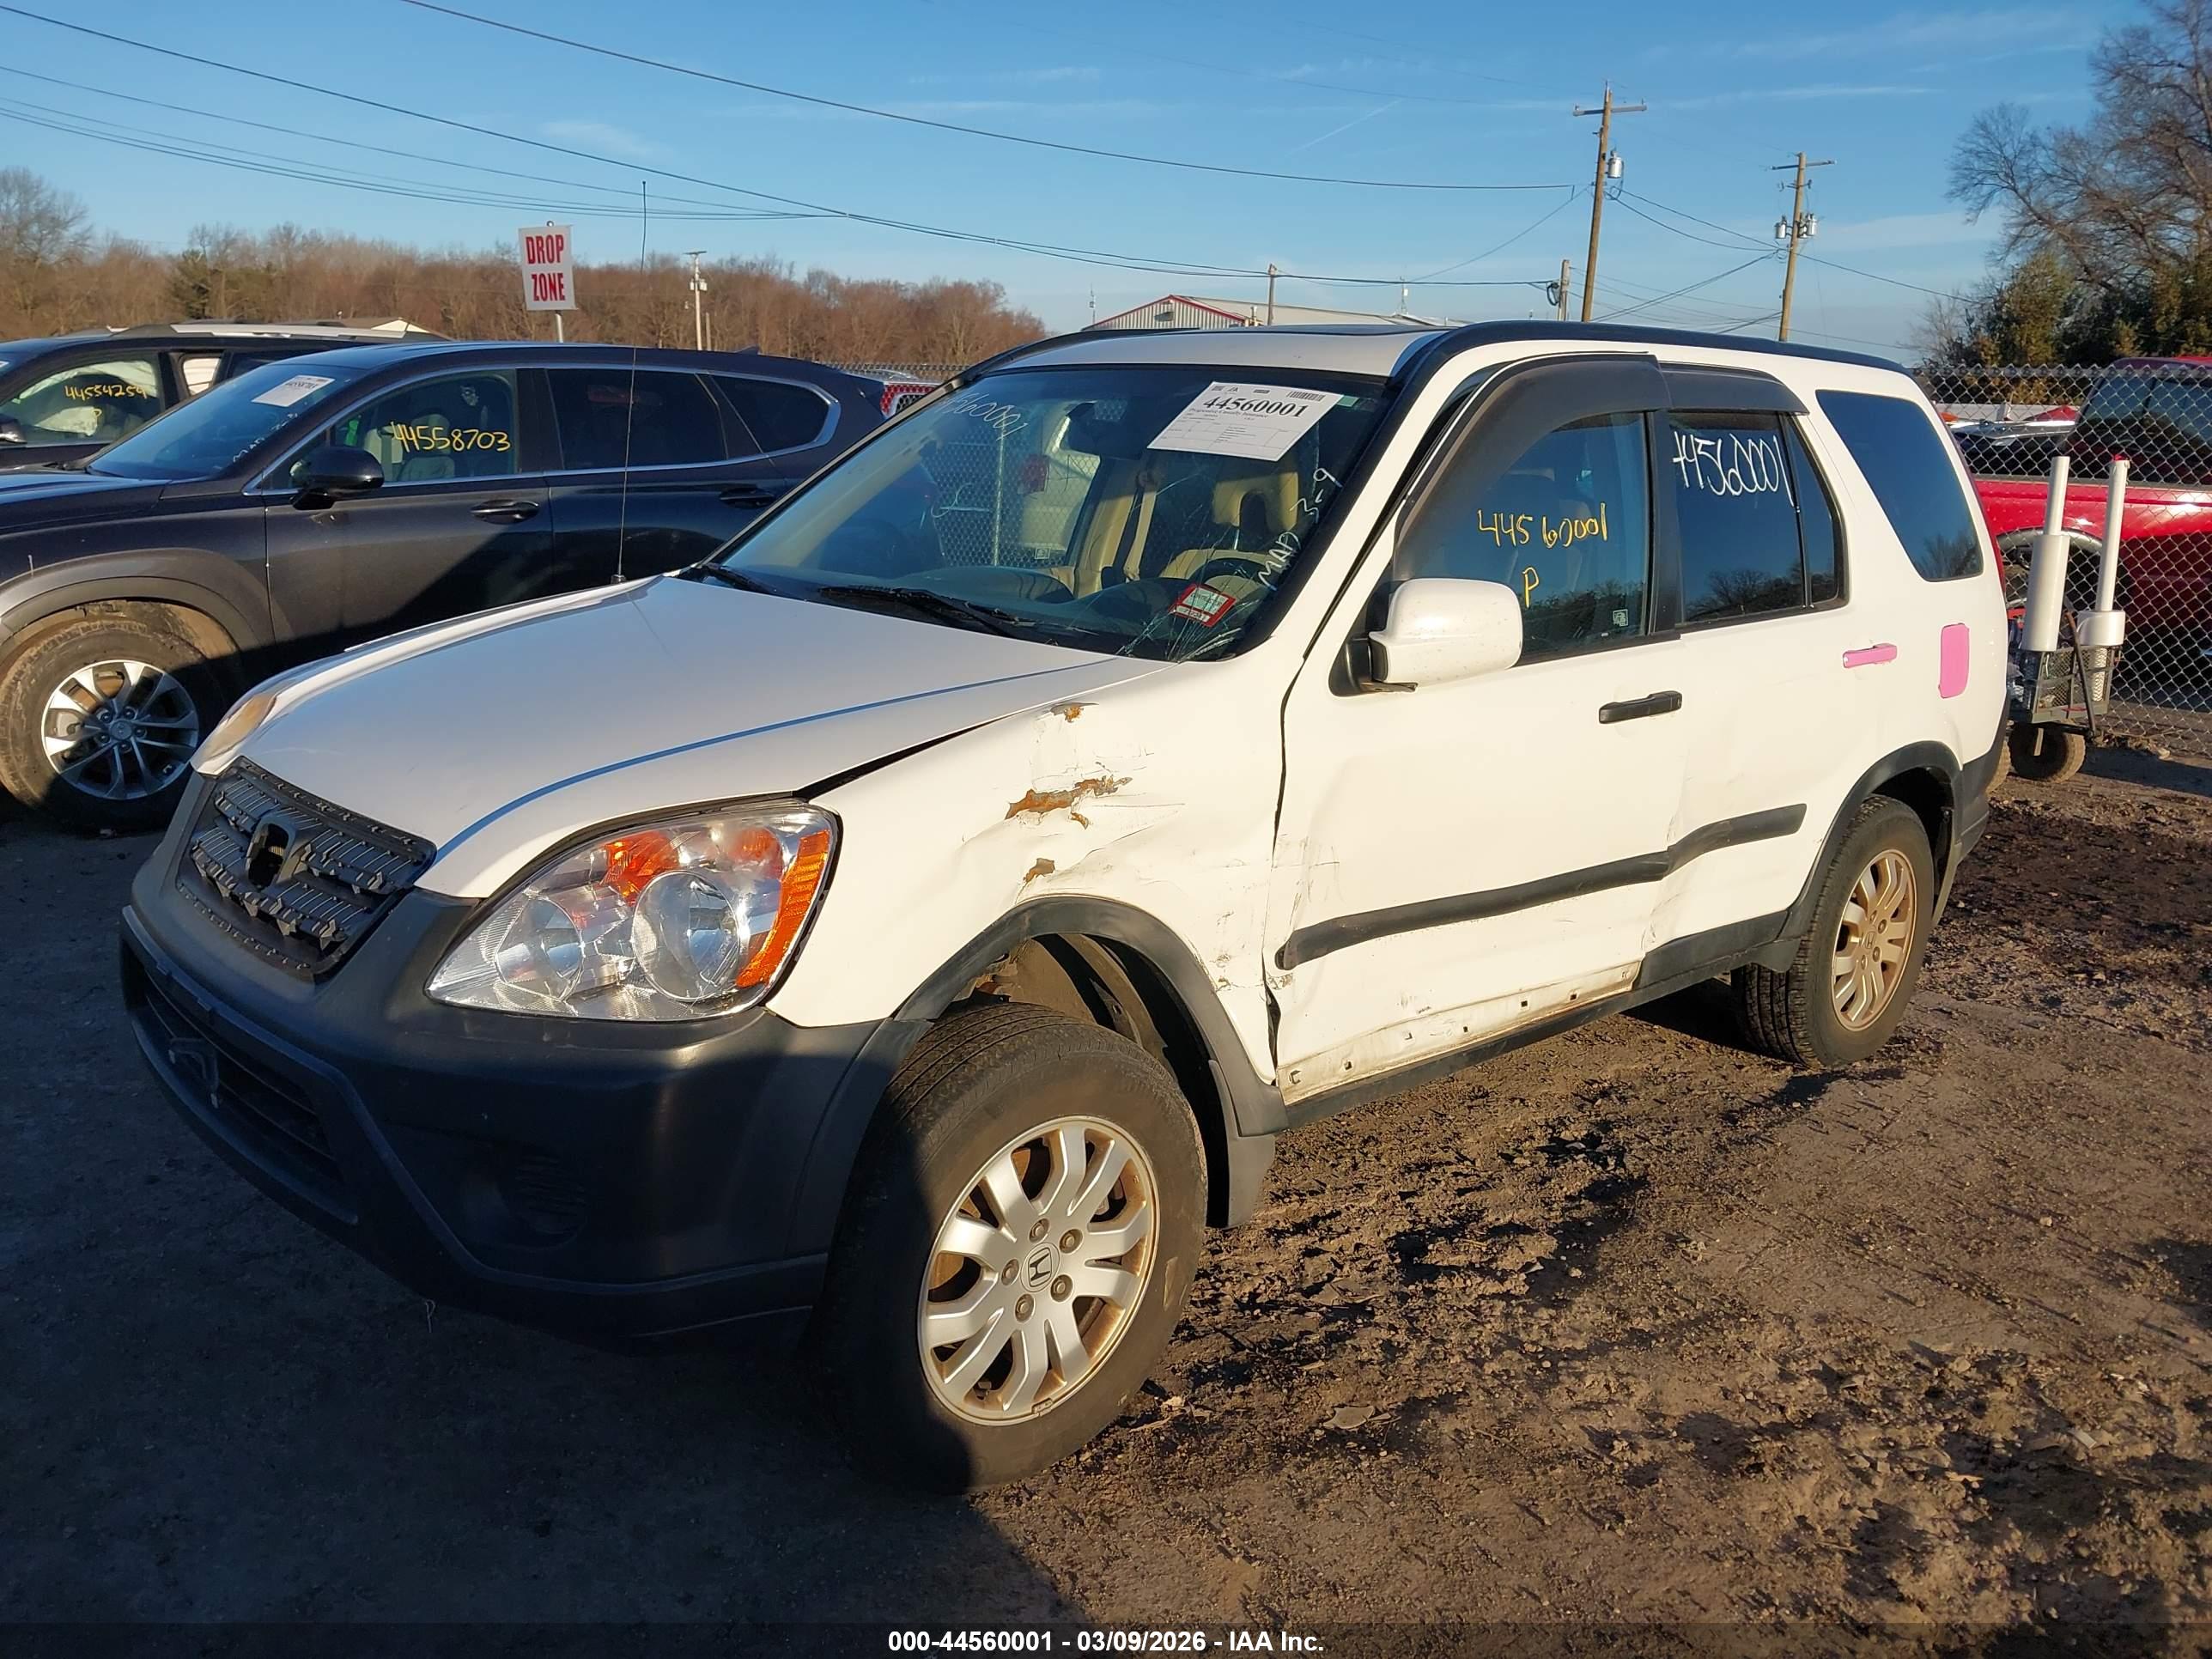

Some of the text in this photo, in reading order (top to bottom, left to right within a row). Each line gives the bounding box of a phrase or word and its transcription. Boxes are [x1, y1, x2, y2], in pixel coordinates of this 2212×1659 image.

[526, 234, 564, 264] DROP
[531, 272, 566, 301] ZONE
[1203, 396, 1310, 418] 44560001
[391, 422, 511, 453] 44558703
[1522, 566, 1540, 609] P
